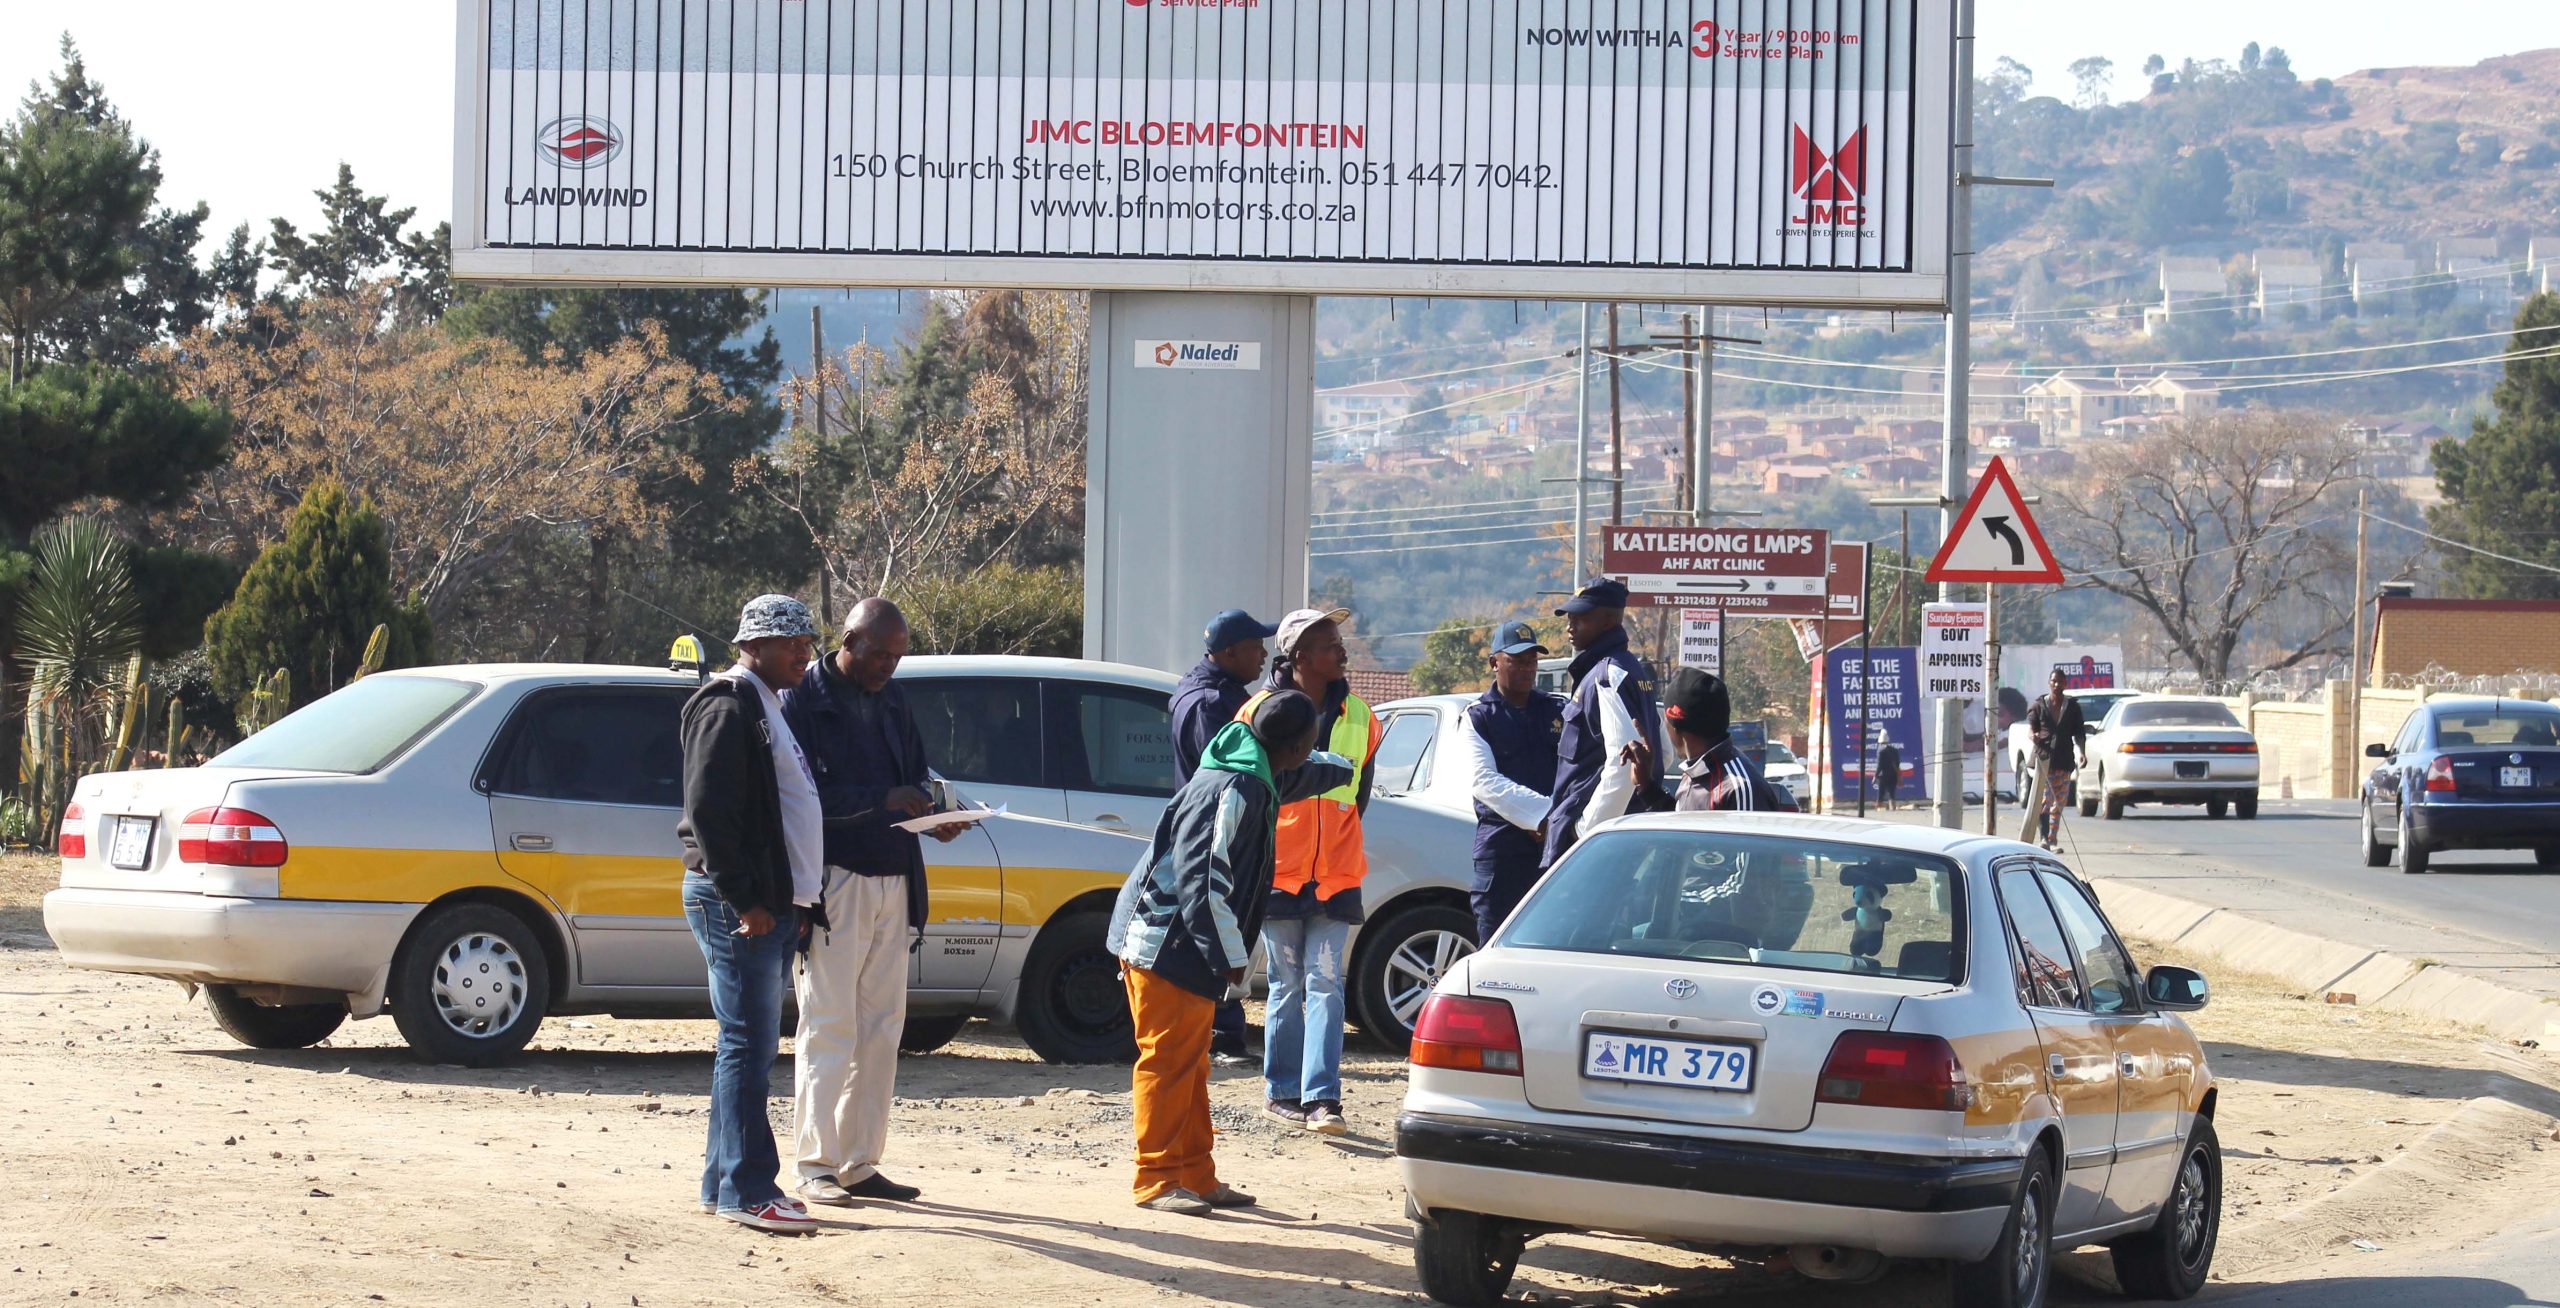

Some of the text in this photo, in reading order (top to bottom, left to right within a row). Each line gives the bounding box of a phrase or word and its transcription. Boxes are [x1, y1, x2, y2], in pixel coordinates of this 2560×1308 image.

[1526, 19, 1720, 59] NOW WITH A 3
[1724, 29, 1761, 43] Year
[1723, 44, 1824, 59] Service Plan
[1025, 119, 1364, 149] JMC BLOEMFONTEIN
[832, 153, 1559, 189] 150 Church Street, Bloemfontein. 051 447 7042.
[504, 186, 648, 208] LANDWIND
[1030, 194, 1356, 222] www.bfnmotors.co.za
[1792, 203, 1867, 226] JMC
[1180, 343, 1240, 361] Naledi
[1612, 532, 1813, 554] KATLEHONG LMPS
[1662, 557, 1765, 571] AHF ART CLINIC
[1653, 595, 1672, 605] TEL.
[1673, 596, 1717, 606] 22312428
[1725, 597, 1769, 607] 22312426
[1692, 621, 1711, 630] GOVT
[1928, 612, 1983, 625] Sunday Express
[1684, 636, 1718, 646] APPOINTS
[1941, 628, 1970, 641] GOVT
[676, 643, 693, 659] TAXI
[1684, 653, 1702, 662] FOUR
[1872, 659, 1900, 674] THE
[1928, 653, 1982, 667] APPOINTS
[2093, 664, 2112, 674] THE
[1929, 678, 1981, 692] FOUR PSs
[2064, 675, 2112, 688] OME
[1845, 708, 1902, 719] AN ENJOY
[1126, 732, 1172, 744] FOR SA
[1824, 1009, 1888, 1023] COROLLA
[1623, 1043, 1746, 1083] MR 379
